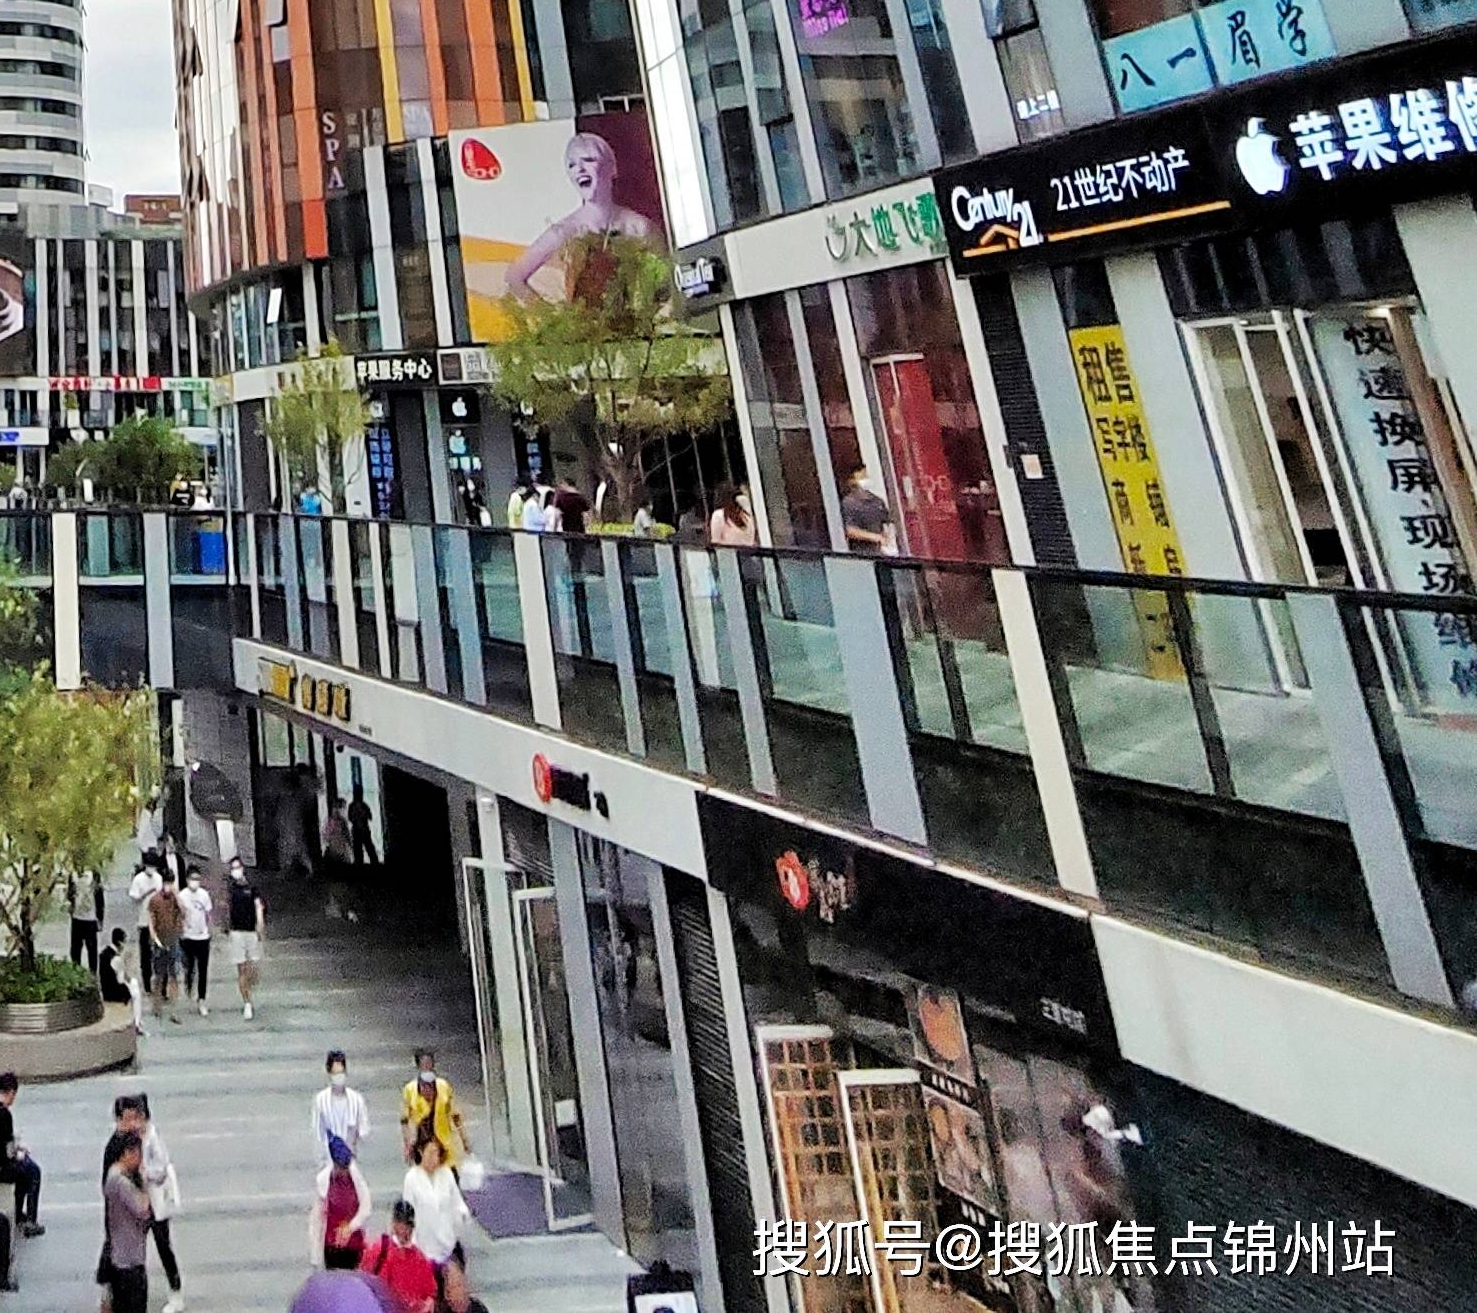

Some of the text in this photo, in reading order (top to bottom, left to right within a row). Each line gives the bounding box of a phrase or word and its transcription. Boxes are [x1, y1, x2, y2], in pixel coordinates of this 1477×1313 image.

[322, 111, 344, 189] SPA
[1050, 145, 1190, 211] 21世纪不动产
[951, 185, 1014, 232] Century
